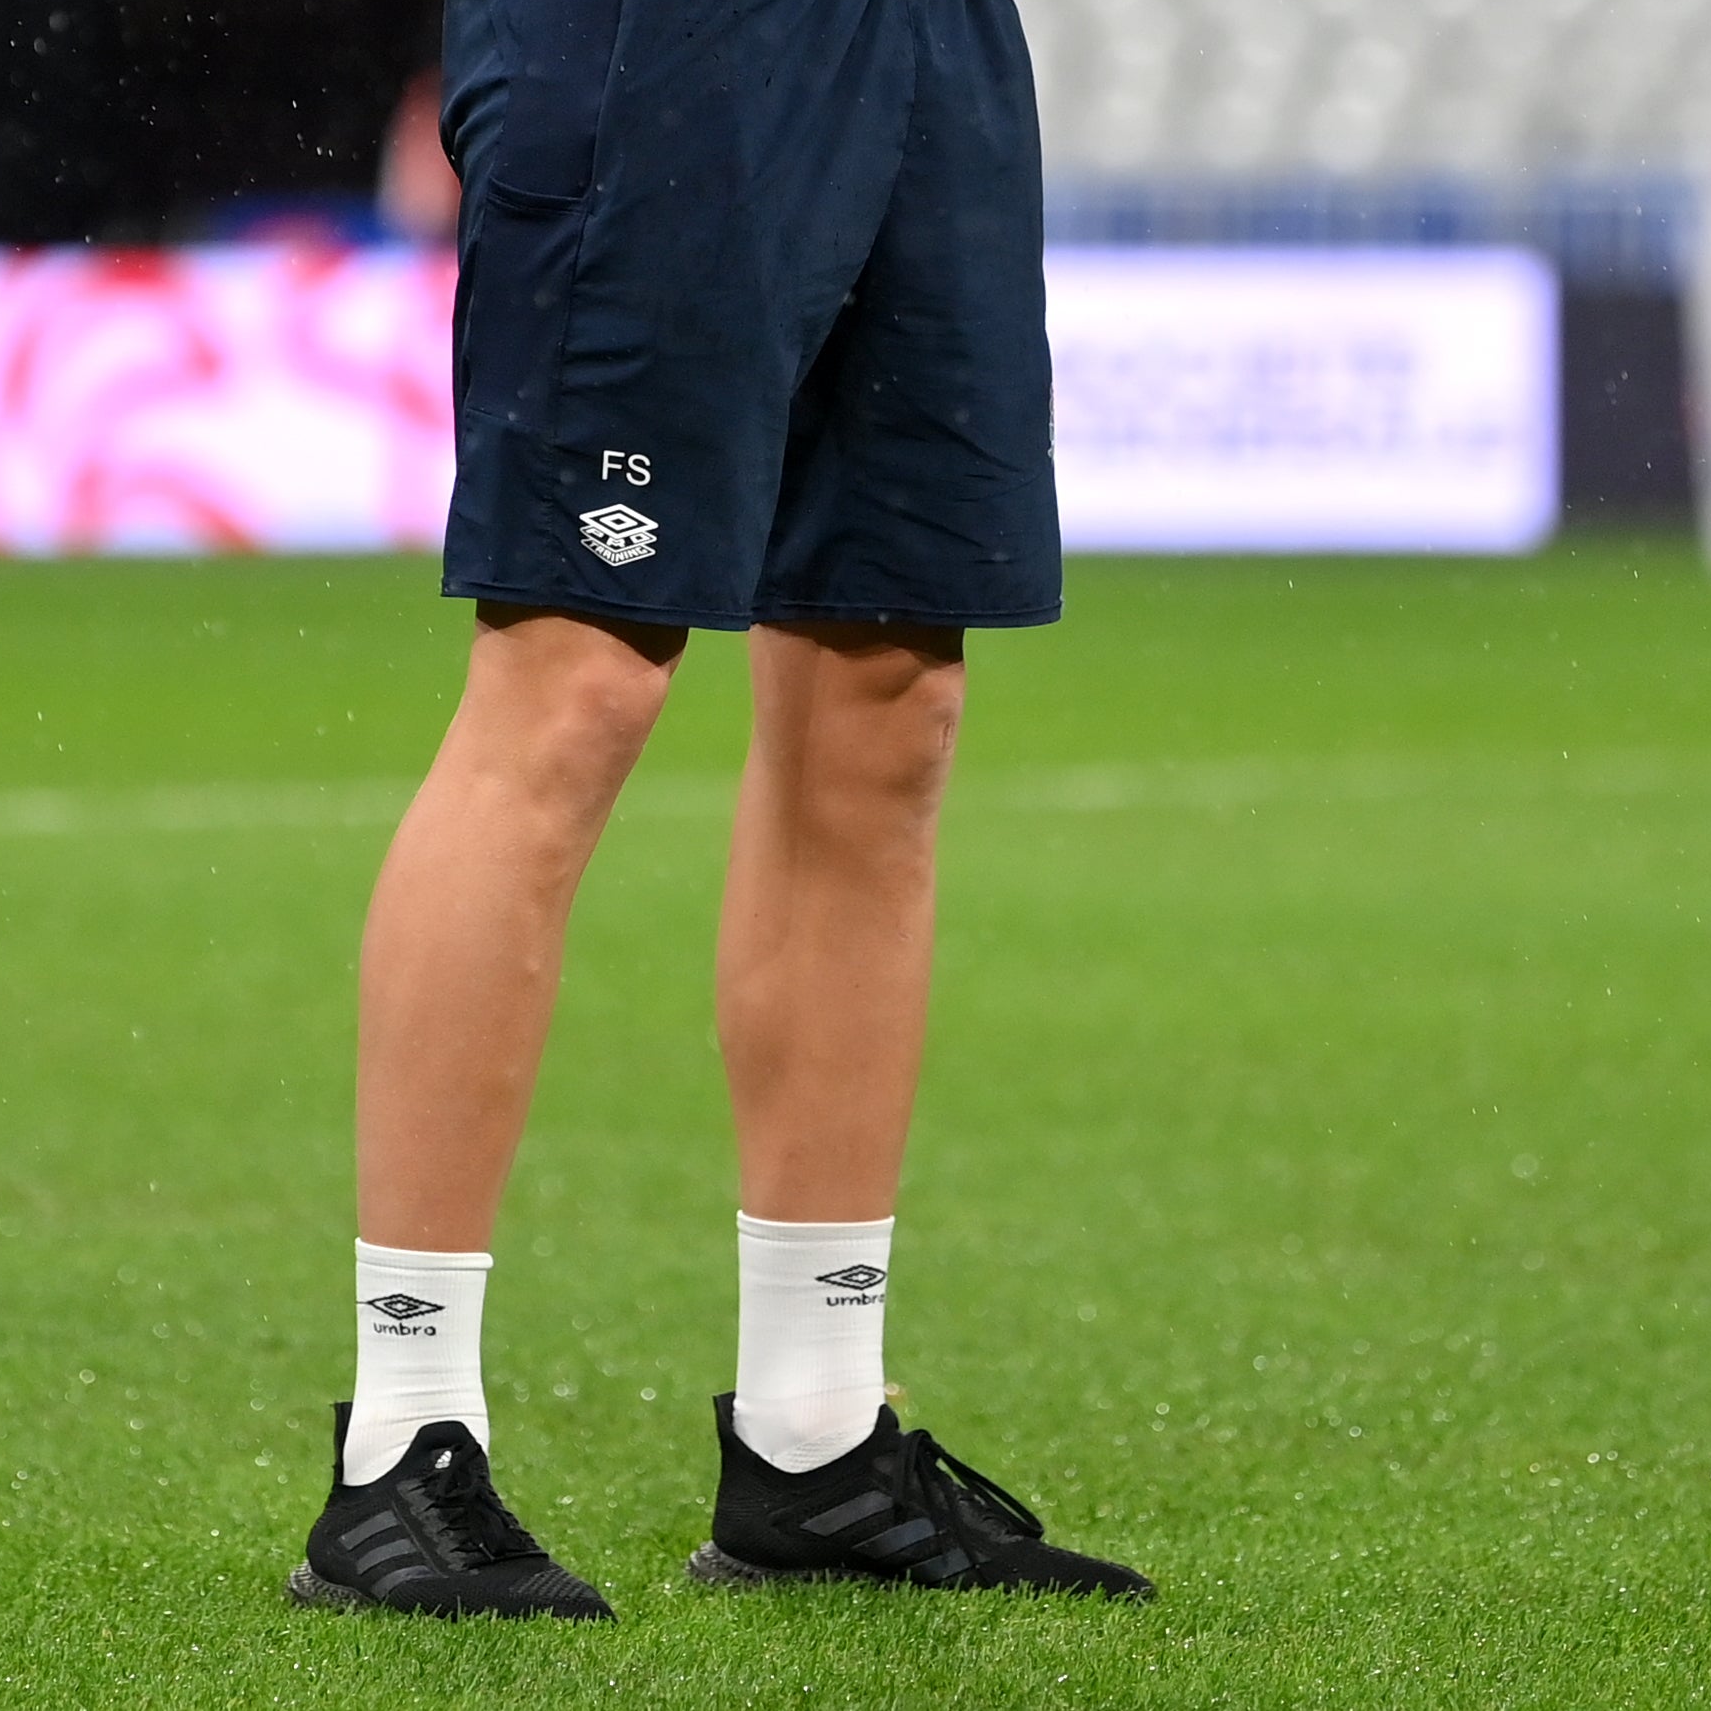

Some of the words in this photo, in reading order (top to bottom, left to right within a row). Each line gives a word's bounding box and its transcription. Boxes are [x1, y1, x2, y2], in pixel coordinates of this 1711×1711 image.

[602, 449, 651, 486] FS
[586, 527, 650, 548] PRO
[373, 1322, 436, 1336] umbro
